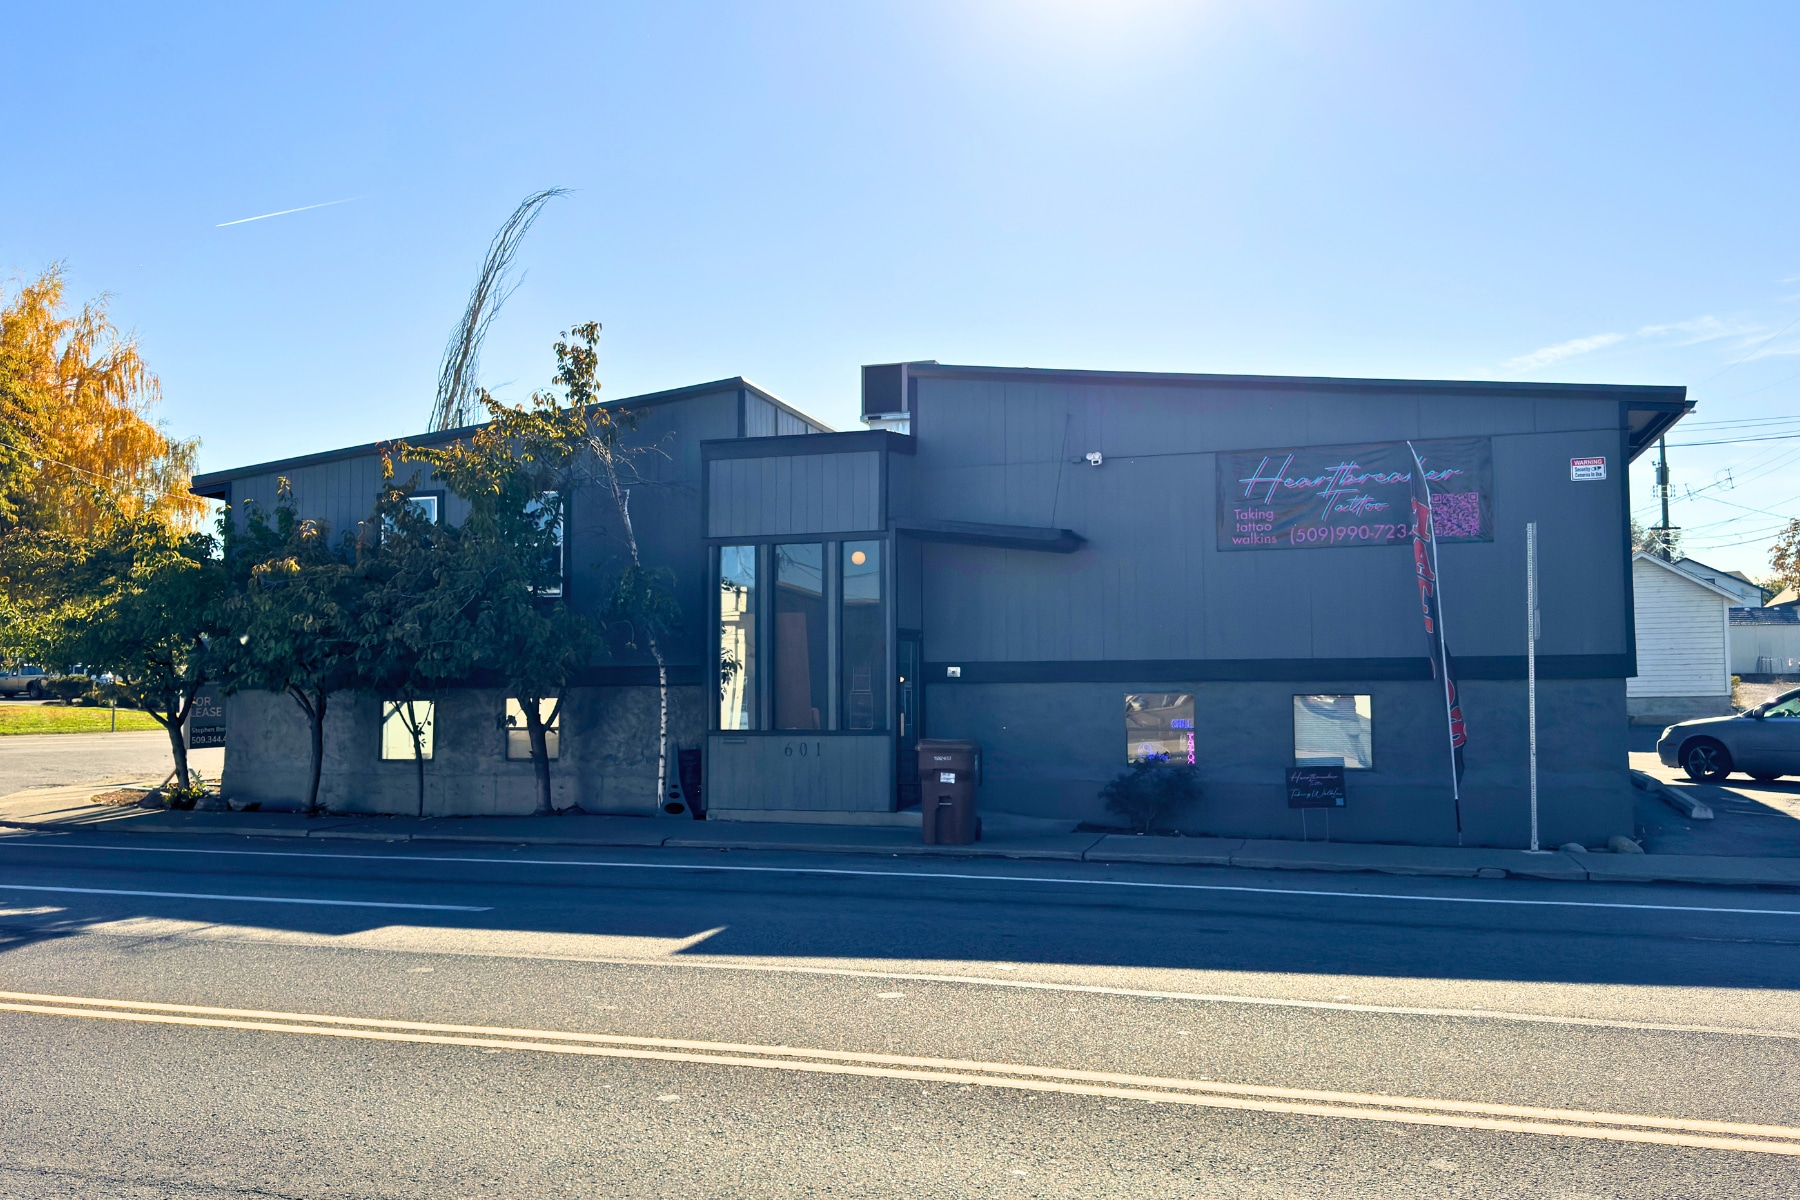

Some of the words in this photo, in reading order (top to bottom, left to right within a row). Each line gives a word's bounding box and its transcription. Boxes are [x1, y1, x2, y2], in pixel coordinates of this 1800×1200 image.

[1239, 454, 1463, 504] Heartbreaer
[1317, 489, 1390, 522] Tattoo
[1234, 507, 1274, 521] Taking
[1236, 522, 1272, 532] tattoo
[1232, 532, 1277, 545] walkins
[193, 696, 211, 707] OR
[784, 742, 821, 757] 601
